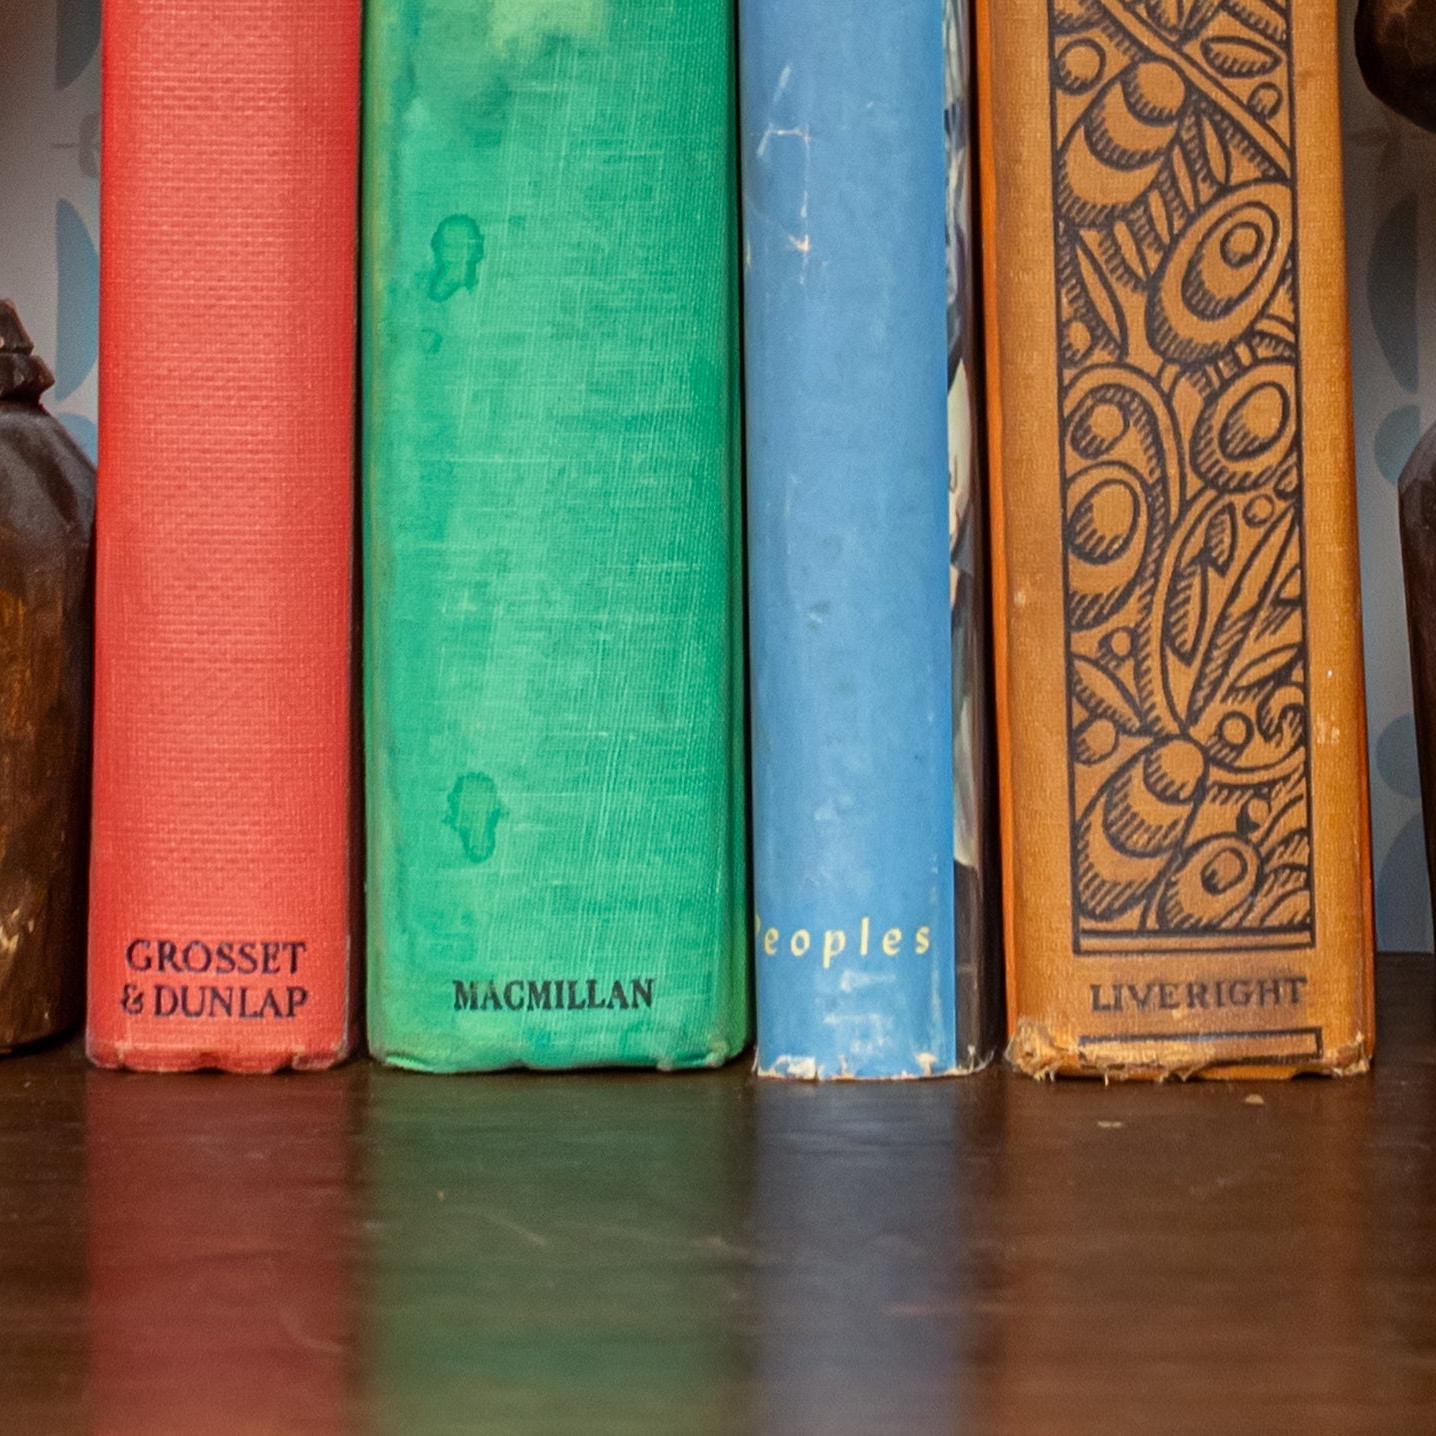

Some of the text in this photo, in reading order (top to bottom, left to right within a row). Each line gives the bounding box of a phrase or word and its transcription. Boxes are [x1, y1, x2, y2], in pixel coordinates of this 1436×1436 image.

[125, 938, 307, 975] GROSSET
[754, 914, 931, 969] eoples
[120, 983, 309, 1018] & DUNLAP
[453, 978, 654, 1012] MACMILLAN
[1089, 976, 1308, 1012] LIVERIGHT
